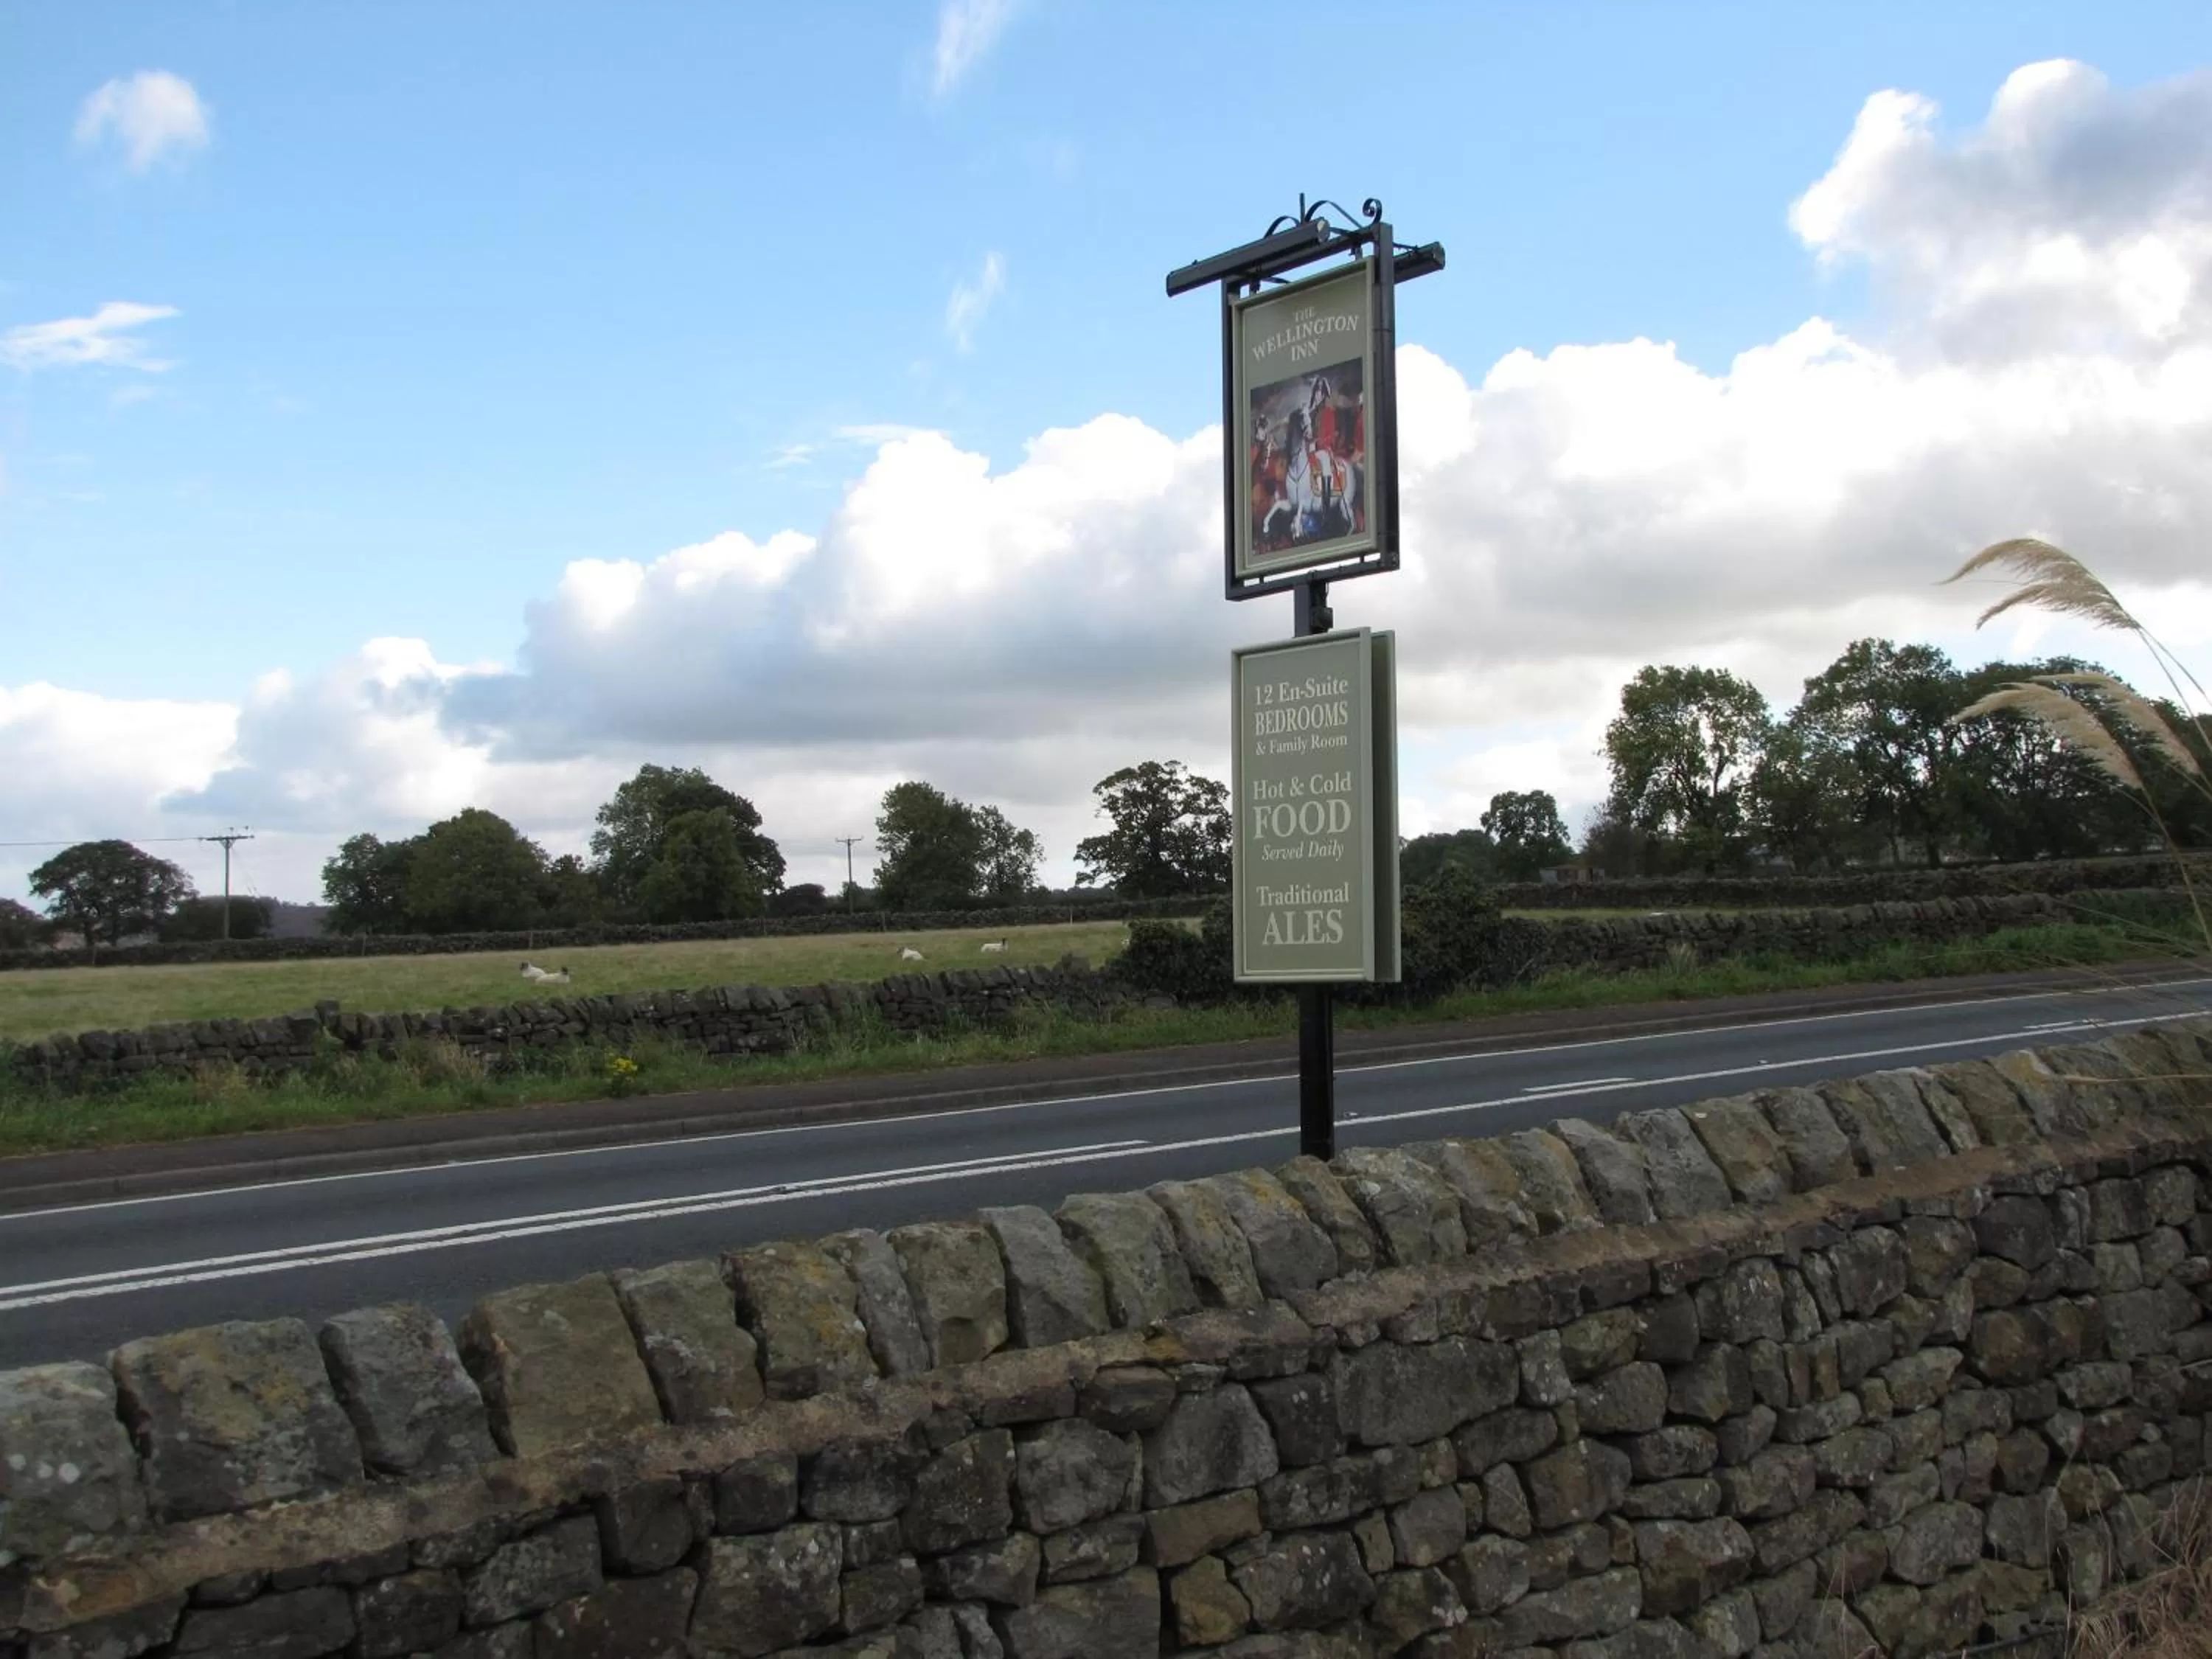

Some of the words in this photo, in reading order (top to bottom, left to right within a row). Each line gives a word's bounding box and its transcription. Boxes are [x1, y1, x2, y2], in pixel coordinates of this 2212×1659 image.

[1294, 307, 1315, 322] THE
[1252, 315, 1359, 361] WELLINGTON
[1290, 339, 1320, 361] INN
[1255, 684, 1273, 706] 12
[1279, 675, 1349, 701] En-Suite
[1254, 700, 1348, 736] BEDROOMS
[1256, 741, 1266, 756] &
[1270, 736, 1307, 755] Family
[1311, 734, 1348, 749] Room
[1253, 779, 1284, 800] Hot
[1290, 776, 1304, 797] &
[1310, 771, 1352, 794] Cold
[1253, 799, 1352, 839] FOOD
[1262, 841, 1304, 861] Served
[1308, 839, 1344, 862] Daily
[1256, 881, 1349, 906] Traditional
[1262, 908, 1344, 945] ALES
